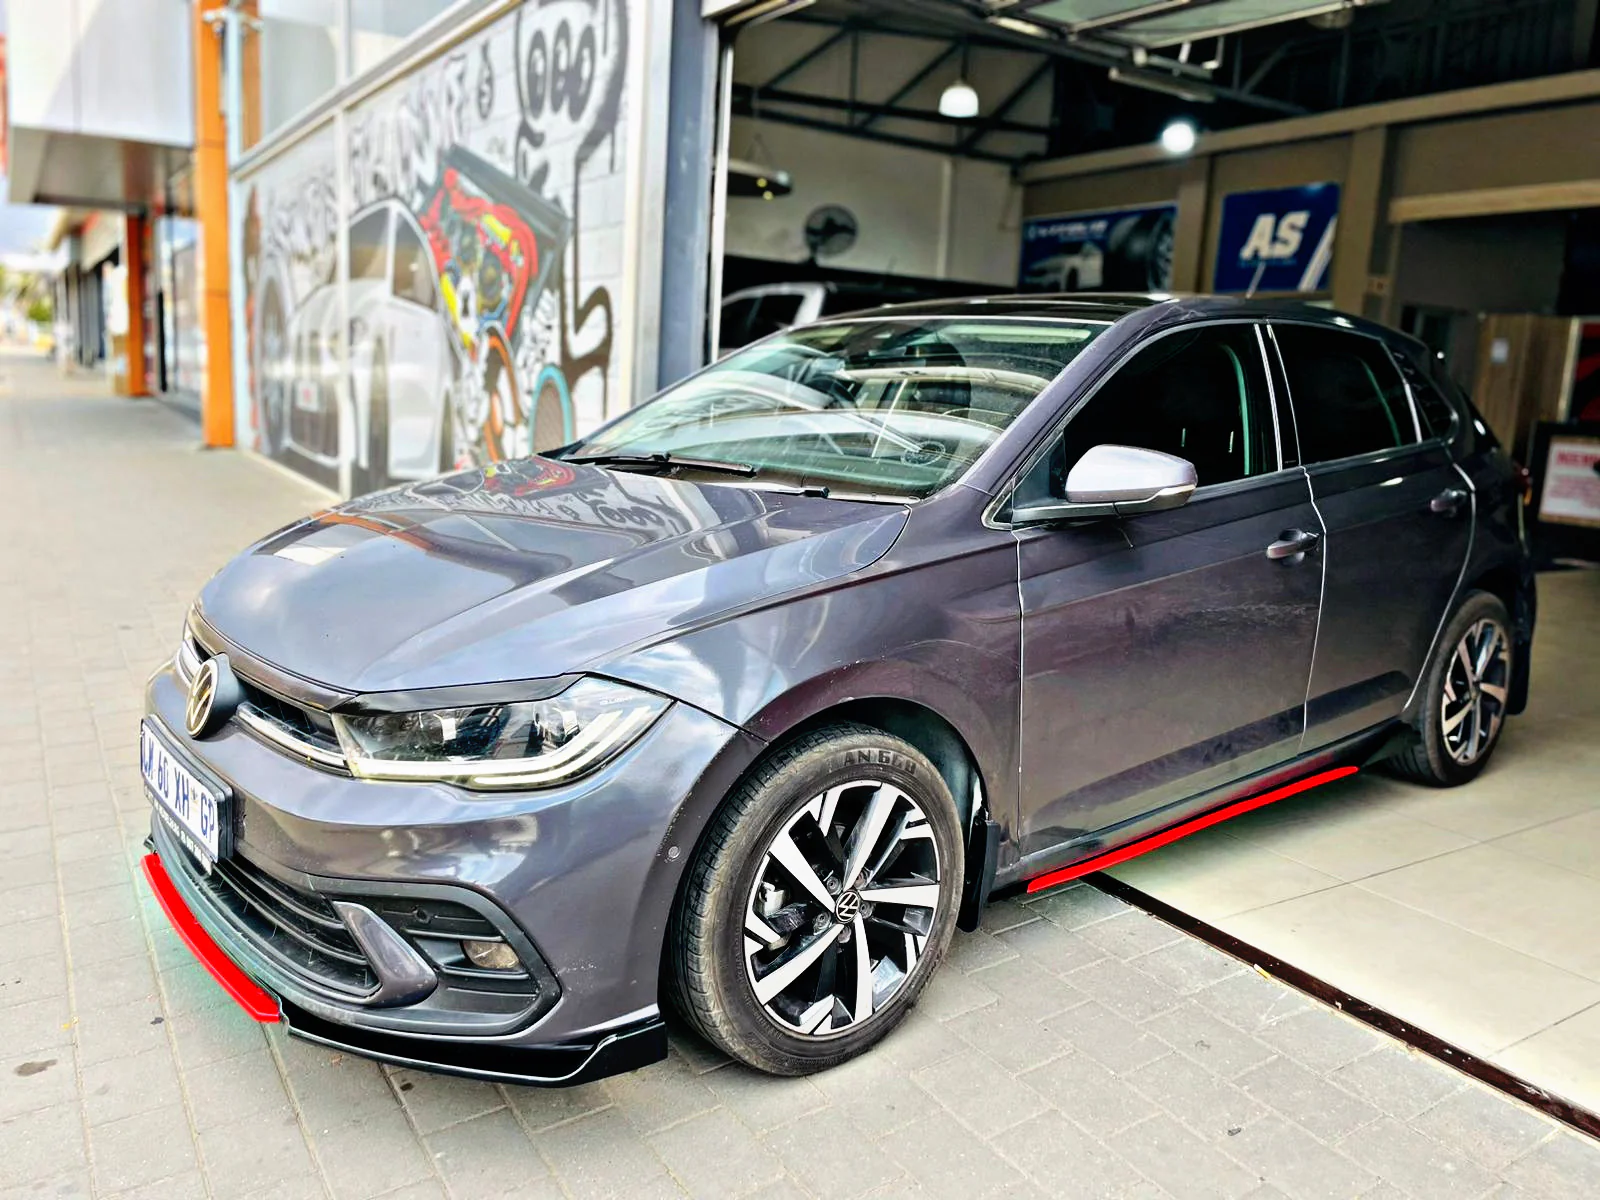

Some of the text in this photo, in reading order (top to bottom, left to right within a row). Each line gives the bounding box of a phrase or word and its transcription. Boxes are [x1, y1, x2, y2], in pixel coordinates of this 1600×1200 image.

[1240, 210, 1310, 260] AS
[174, 767, 190, 820] XH
[200, 791, 215, 844] GP
